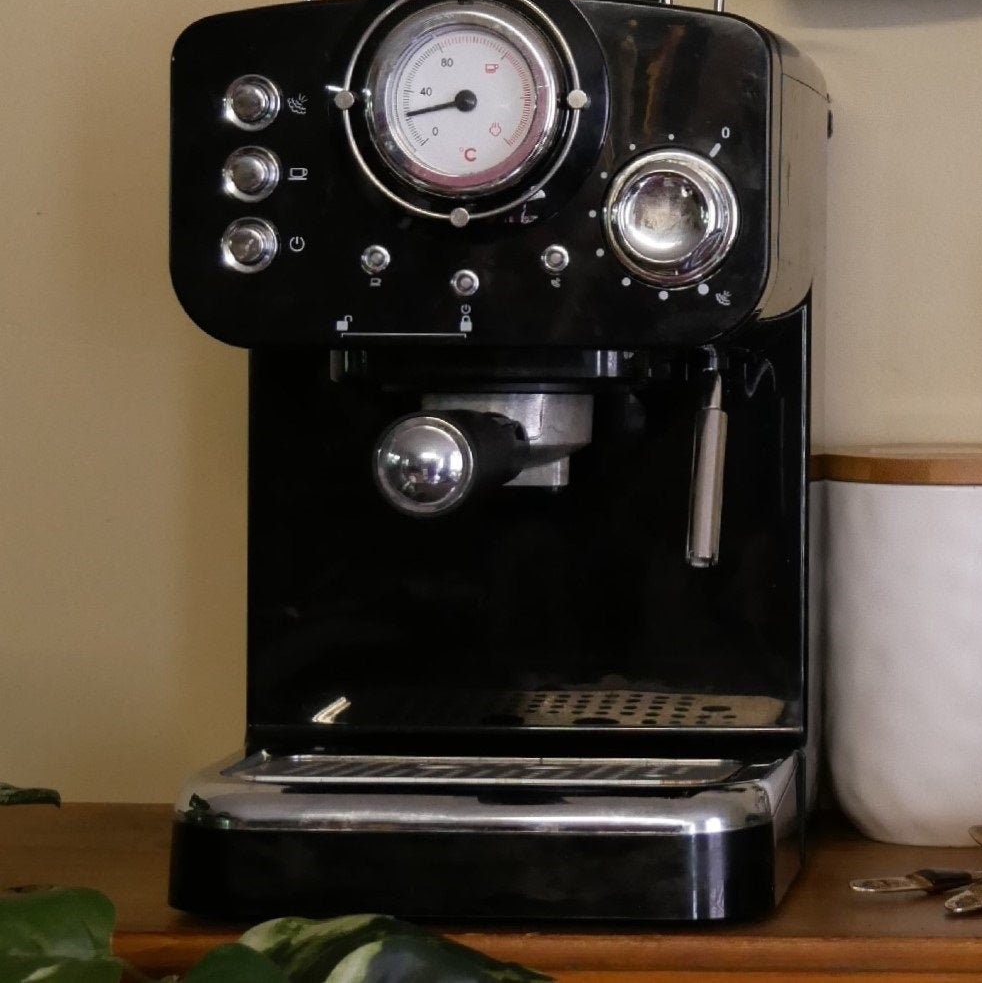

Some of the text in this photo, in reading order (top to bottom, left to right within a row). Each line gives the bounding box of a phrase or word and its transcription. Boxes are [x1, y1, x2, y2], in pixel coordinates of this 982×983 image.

[441, 57, 454, 68] 80
[420, 86, 433, 97] 40
[431, 126, 439, 136] 0
